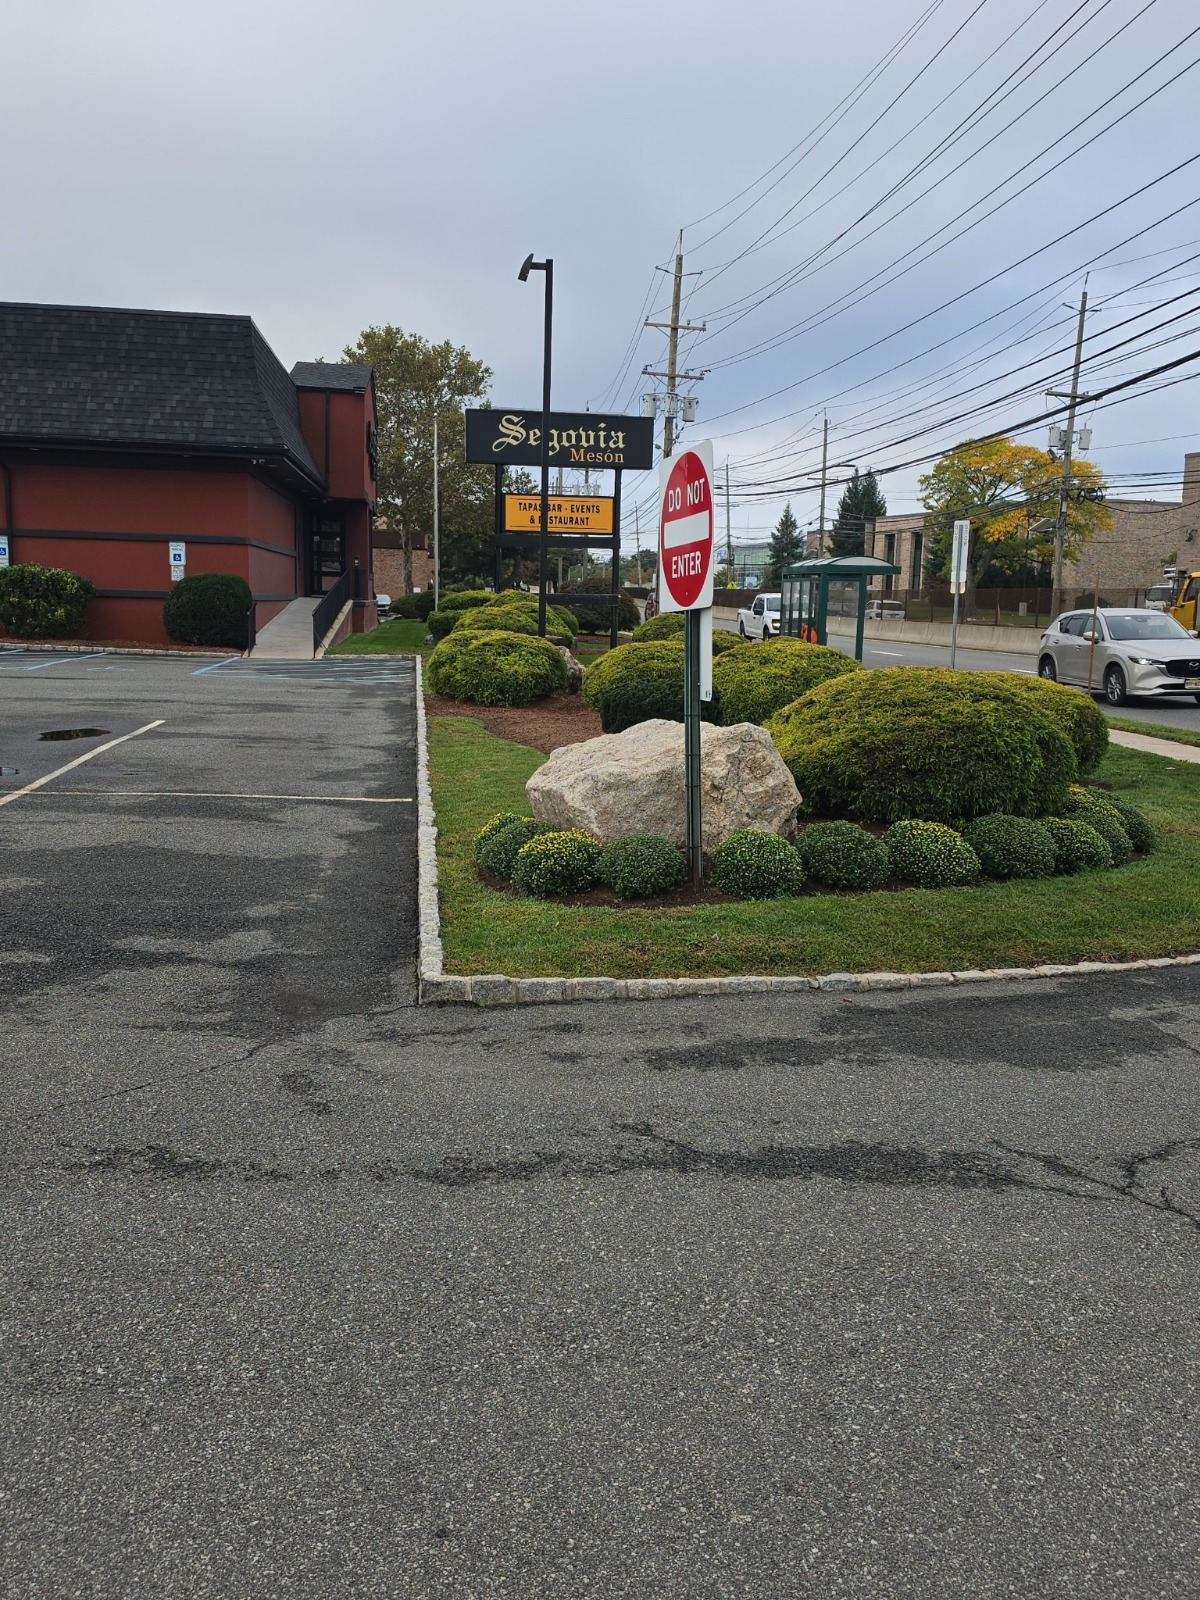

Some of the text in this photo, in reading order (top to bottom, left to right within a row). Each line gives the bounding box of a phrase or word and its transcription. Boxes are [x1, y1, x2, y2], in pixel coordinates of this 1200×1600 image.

[569, 448, 625, 463] Mesón
[668, 478, 705, 512] DO NOT
[570, 504, 601, 514] EVENTS
[529, 515, 535, 525] &
[671, 551, 702, 579] ENTER
